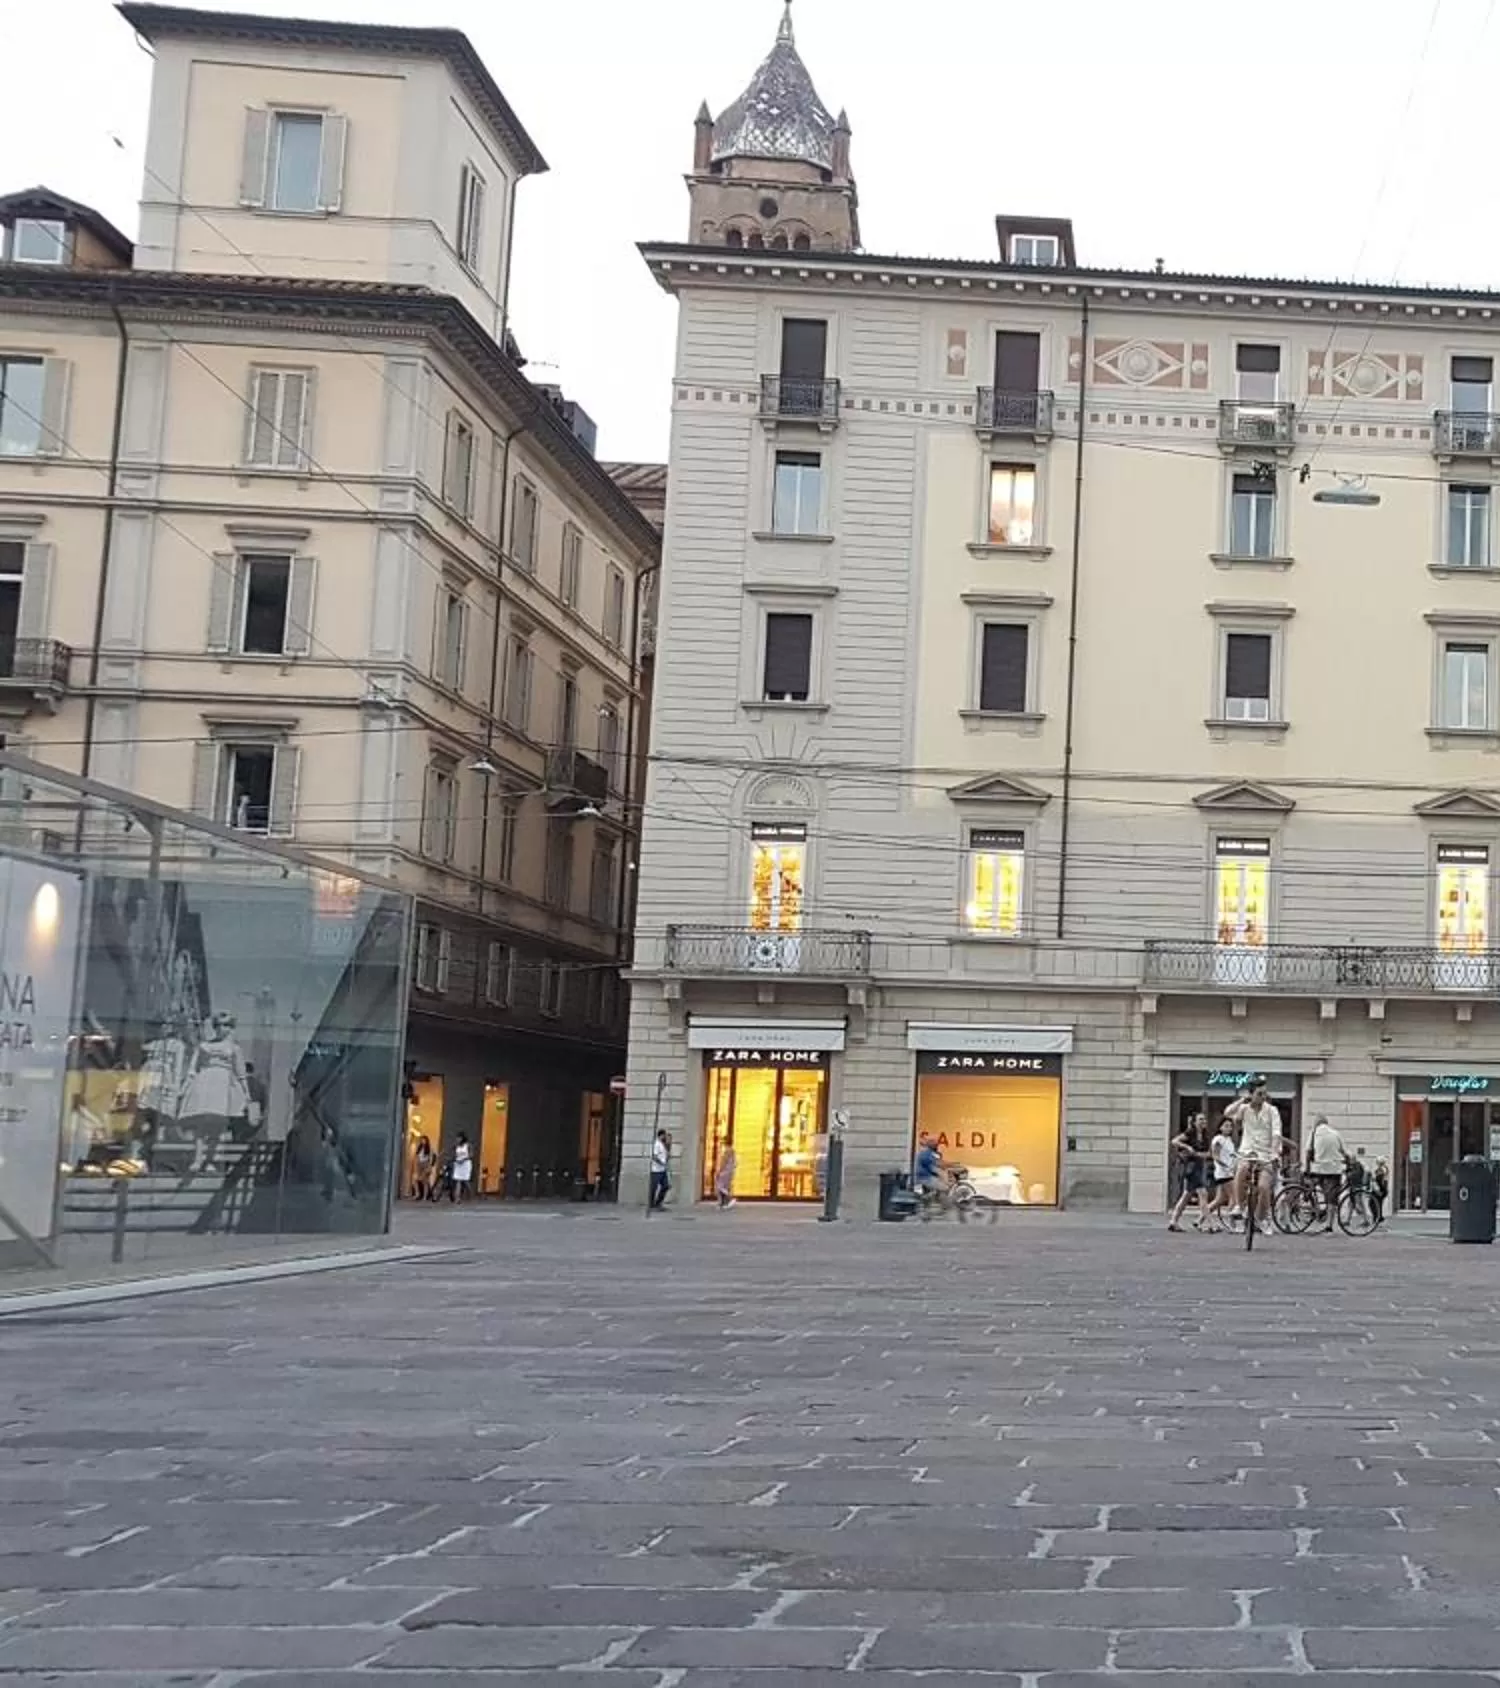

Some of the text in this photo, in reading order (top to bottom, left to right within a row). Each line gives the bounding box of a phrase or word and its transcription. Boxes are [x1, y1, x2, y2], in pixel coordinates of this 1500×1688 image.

[0, 1020, 34, 1049] ATA
[713, 1051, 820, 1063] ZARA HOME
[937, 1056, 1043, 1069] ZARA HOME
